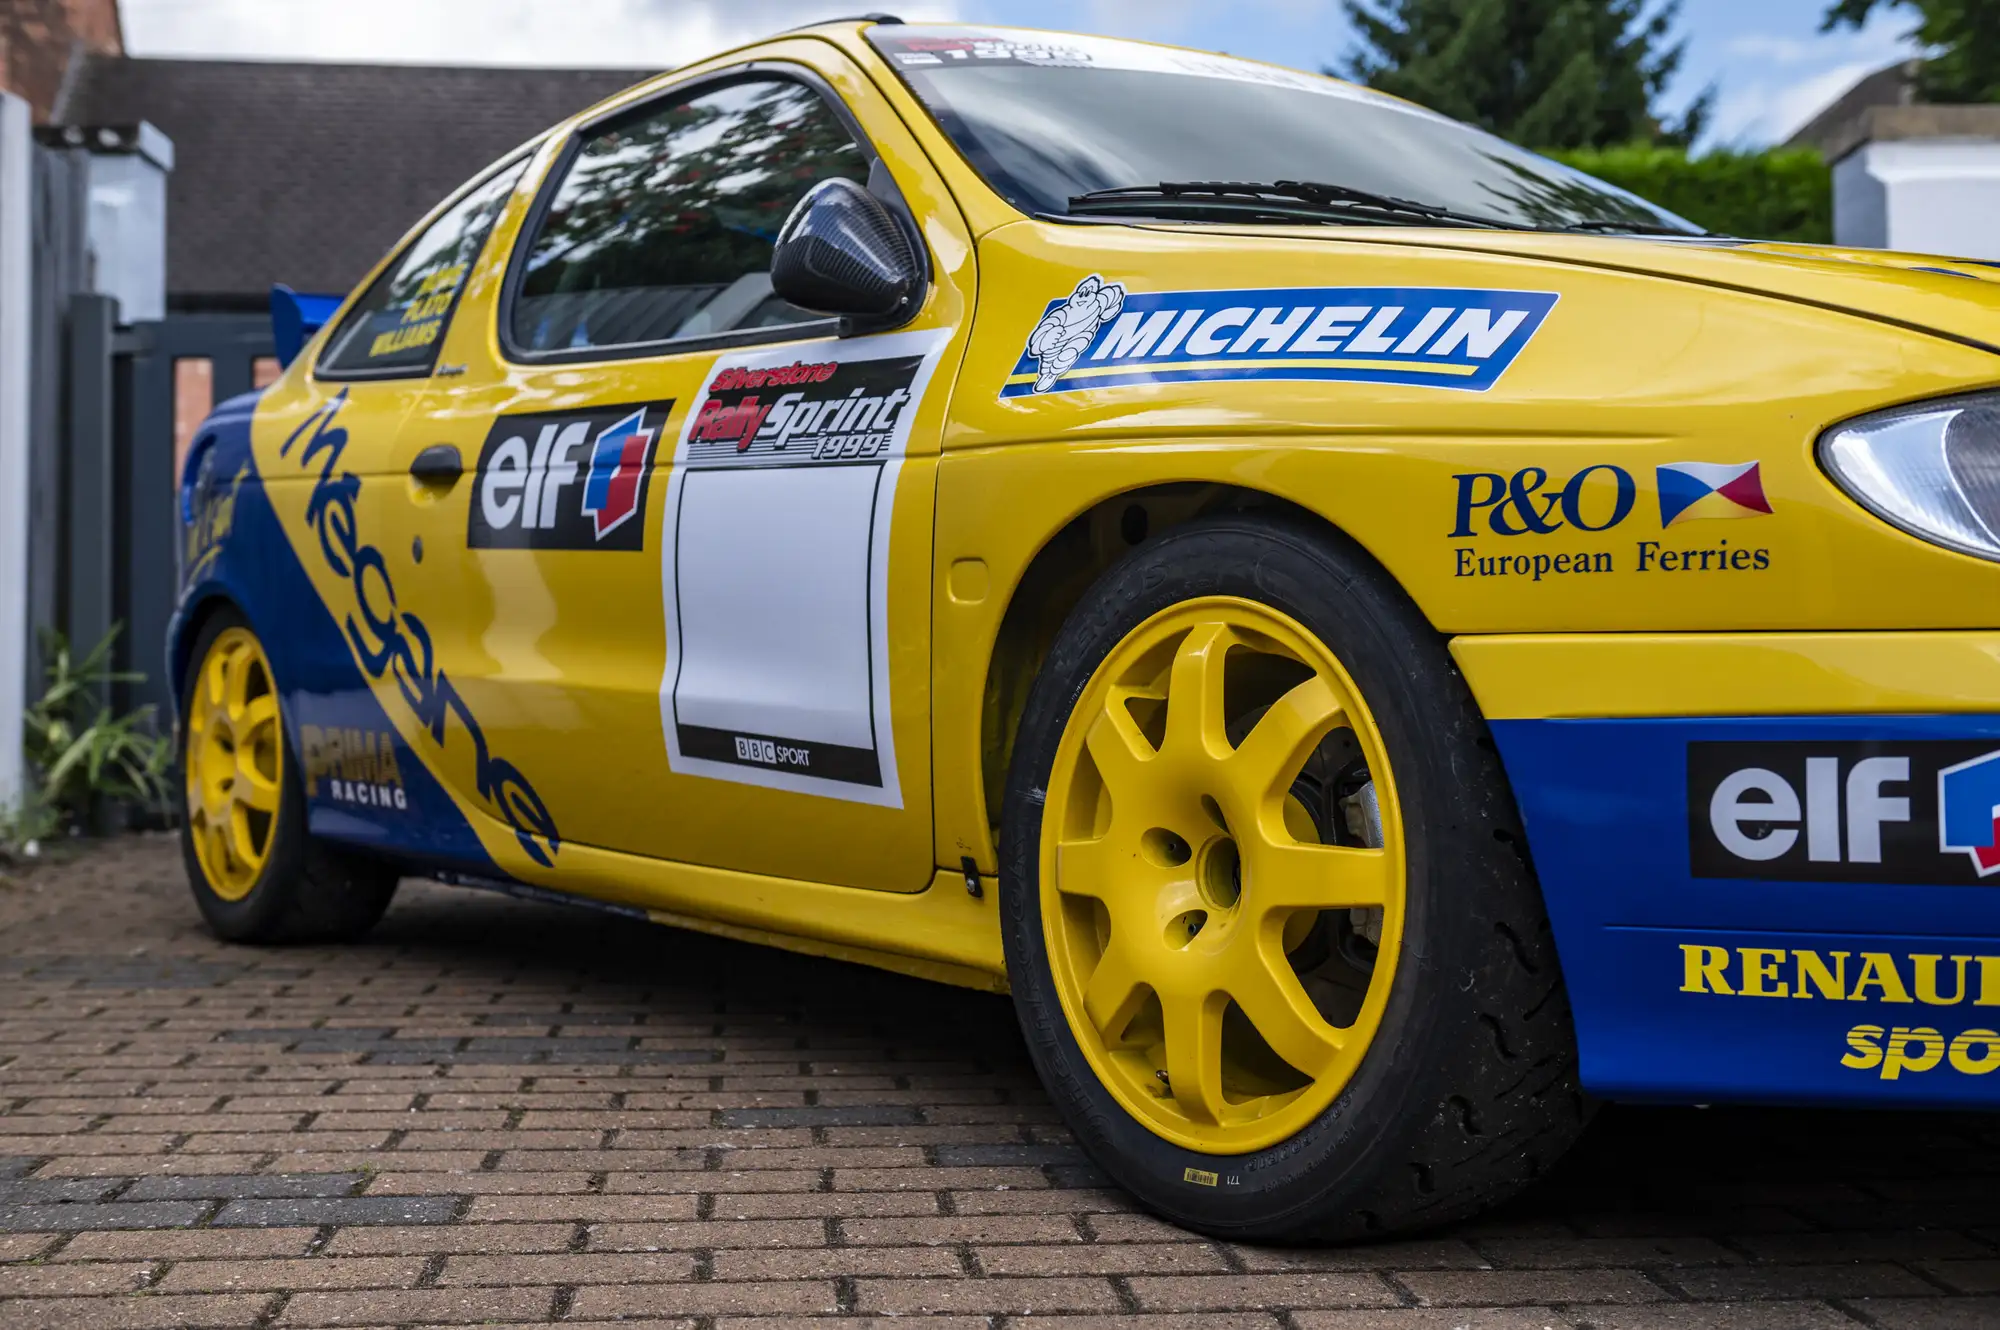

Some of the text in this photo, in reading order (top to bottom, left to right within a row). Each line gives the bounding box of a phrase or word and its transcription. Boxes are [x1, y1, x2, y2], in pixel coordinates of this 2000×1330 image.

[1090, 306, 1530, 360] MICHELIN
[709, 361, 839, 392] Silverstone
[811, 433, 882, 460] 1999
[481, 421, 592, 530] elf
[1447, 464, 1637, 538] P&O
[1454, 539, 1771, 582] European Ferries
[300, 724, 403, 797] PRIMA
[735, 736, 810, 767] BBC SPORT
[331, 779, 407, 810] RACING
[1709, 756, 1911, 863] elf
